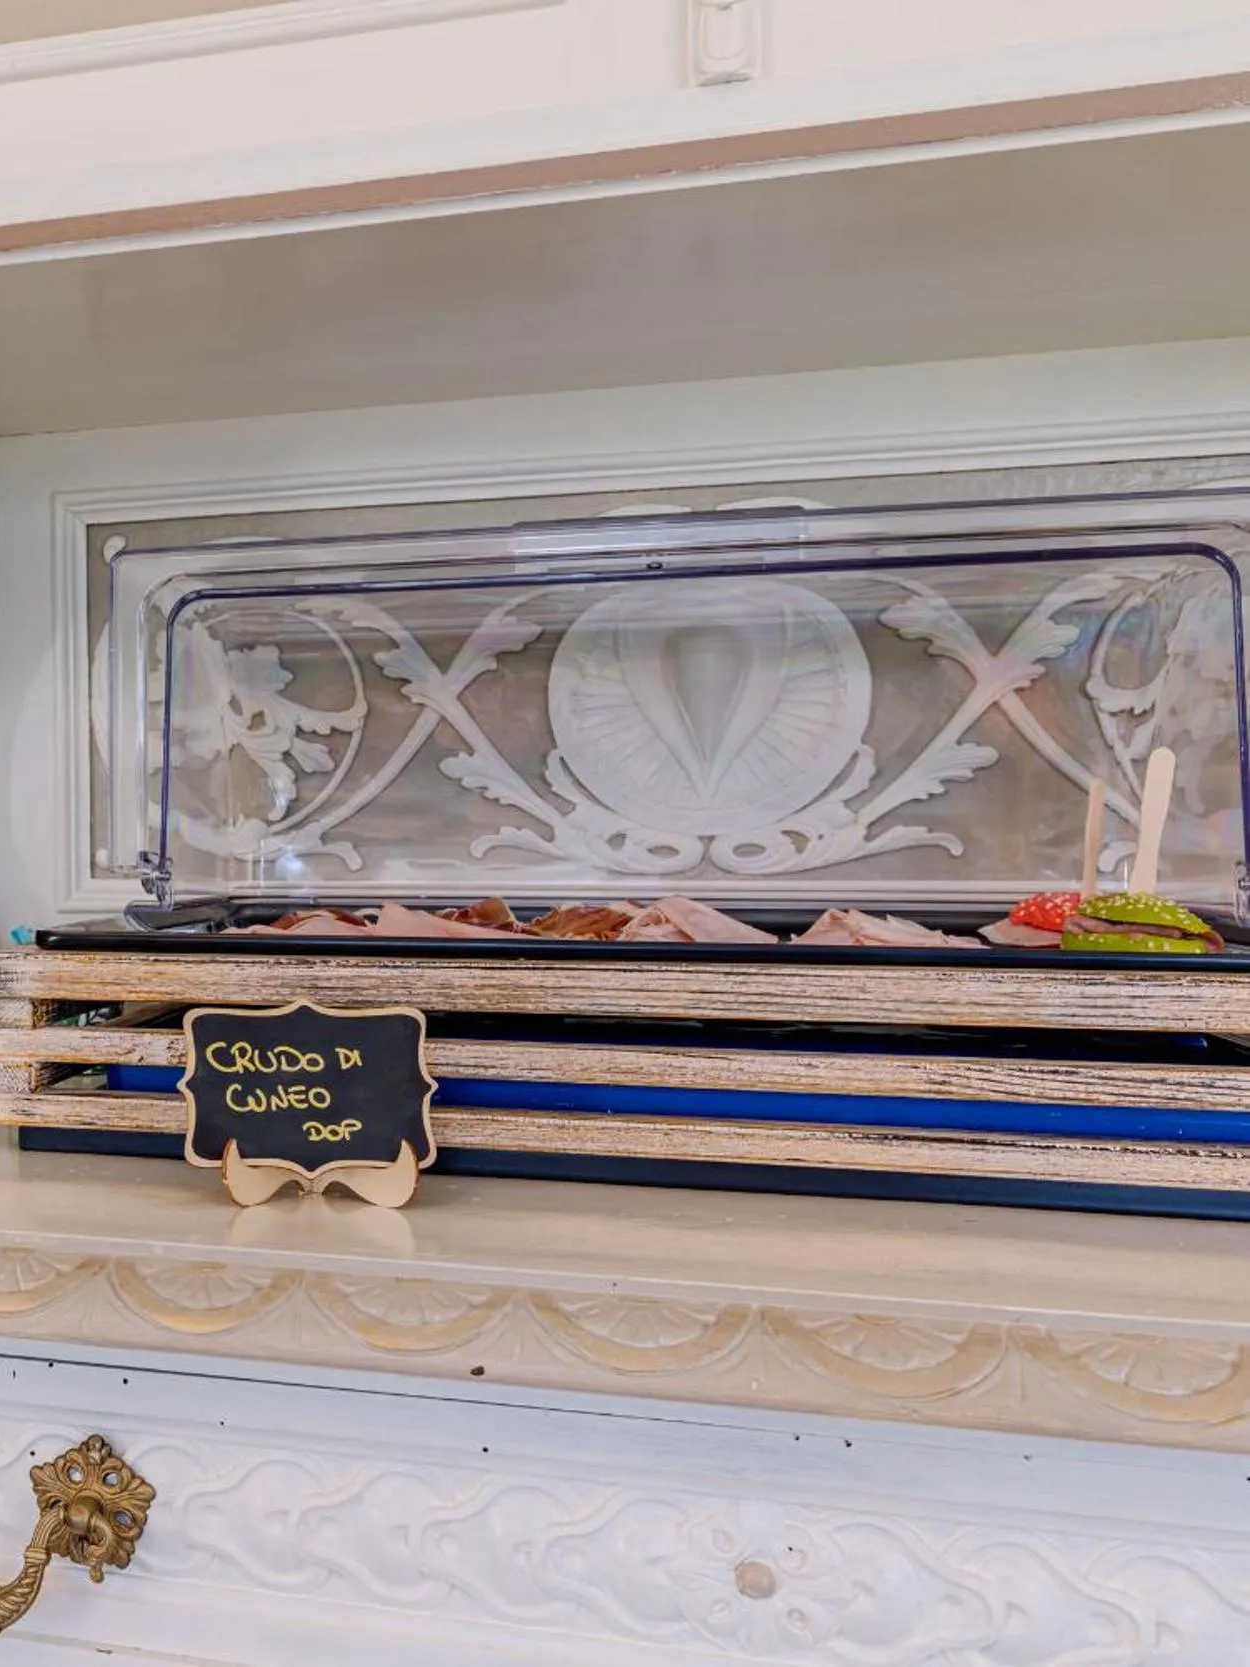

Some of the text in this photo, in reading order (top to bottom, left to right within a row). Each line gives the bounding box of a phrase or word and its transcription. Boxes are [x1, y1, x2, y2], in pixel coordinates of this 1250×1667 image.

[205, 1041, 363, 1075] CRUDO DI
[226, 1084, 331, 1113] CUNEO
[302, 1119, 363, 1143] DOP
